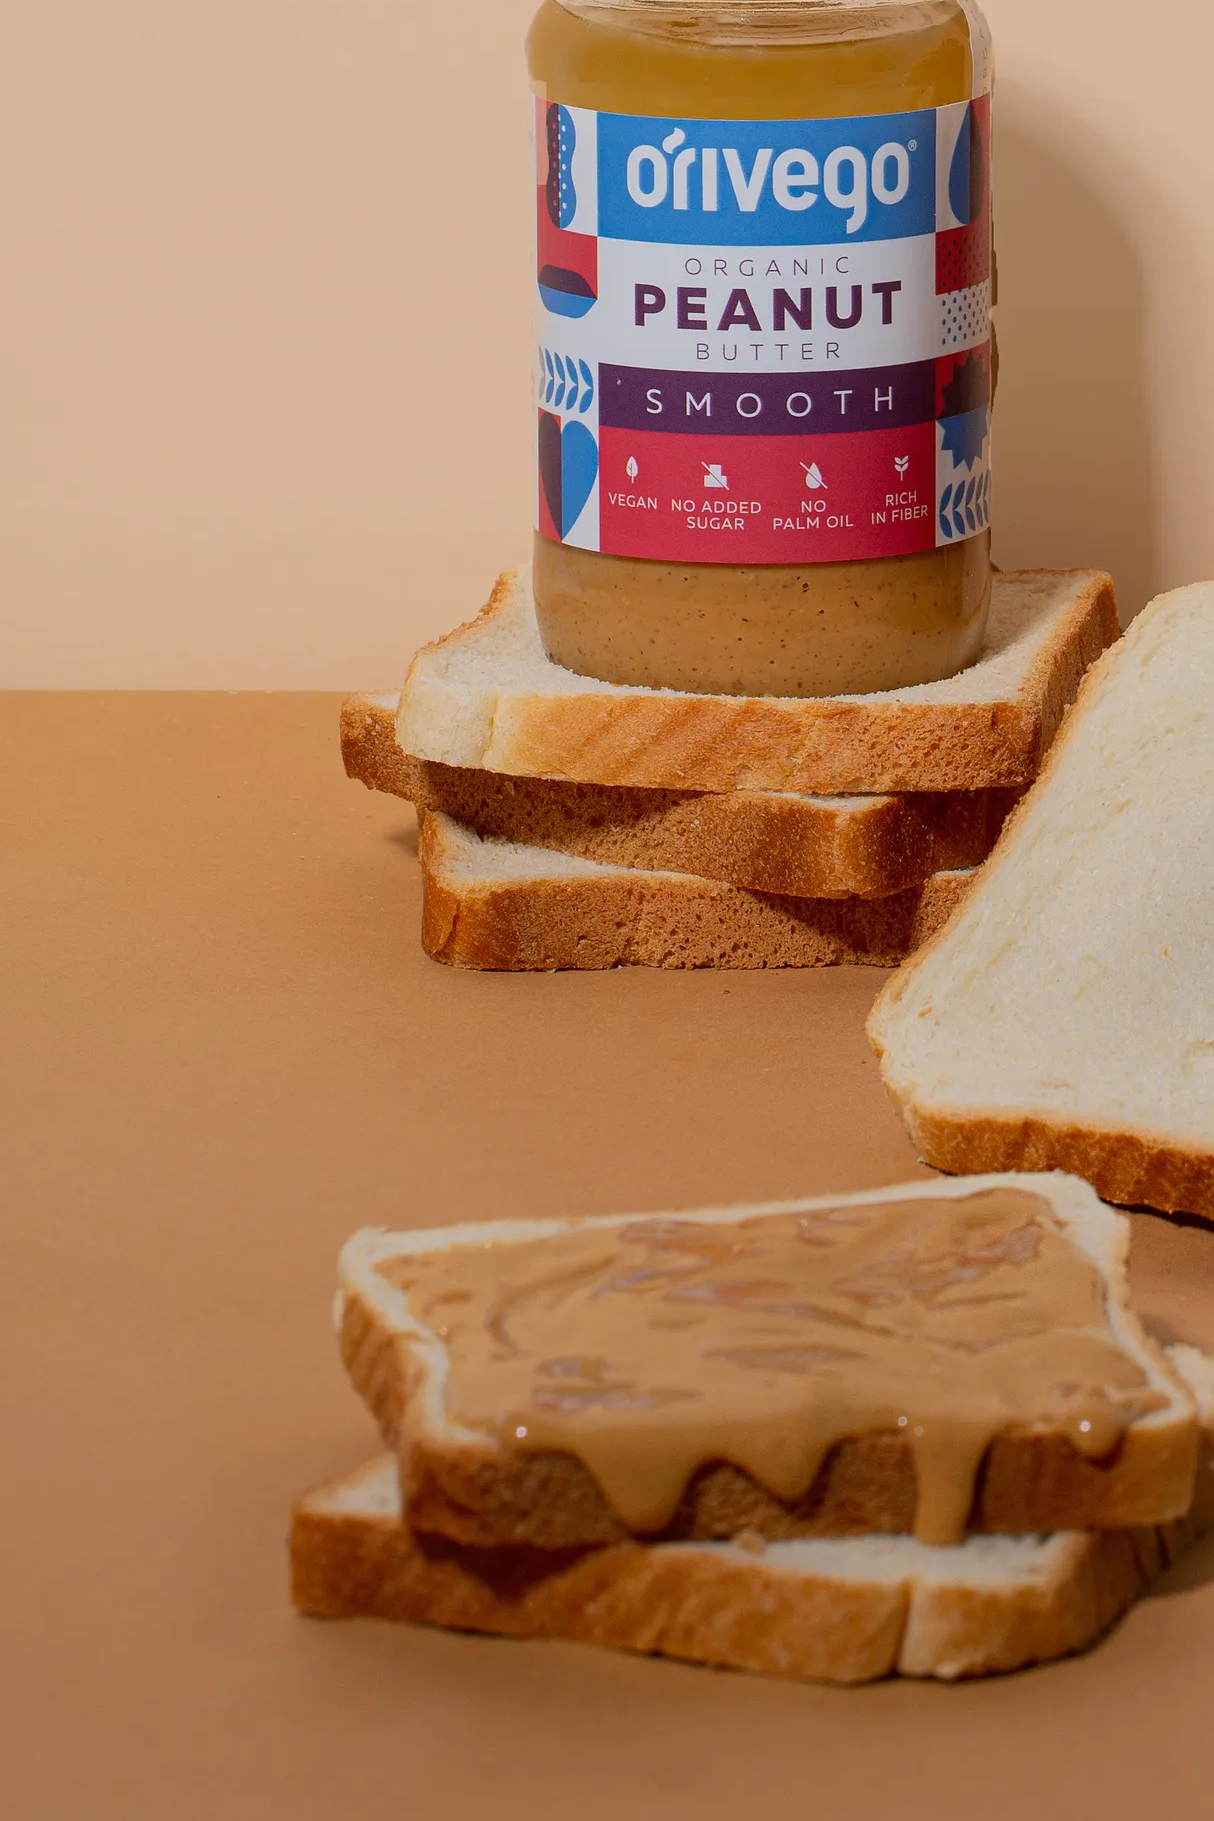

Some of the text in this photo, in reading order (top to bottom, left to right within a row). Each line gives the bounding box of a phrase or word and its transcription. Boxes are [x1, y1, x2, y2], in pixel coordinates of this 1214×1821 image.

[685, 256, 850, 277] ORGANIC
[634, 280, 902, 331] PEANUT
[696, 342, 840, 361] BUTTER
[646, 386, 893, 417] SMOOTH
[608, 492, 658, 510] VEGAN
[671, 500, 762, 515] NO ADDED
[800, 500, 827, 514] NO
[885, 491, 917, 507] RICH
[686, 516, 745, 532] SUGAR
[773, 515, 854, 532] PALM OIL
[871, 505, 929, 526] IN FIBER
